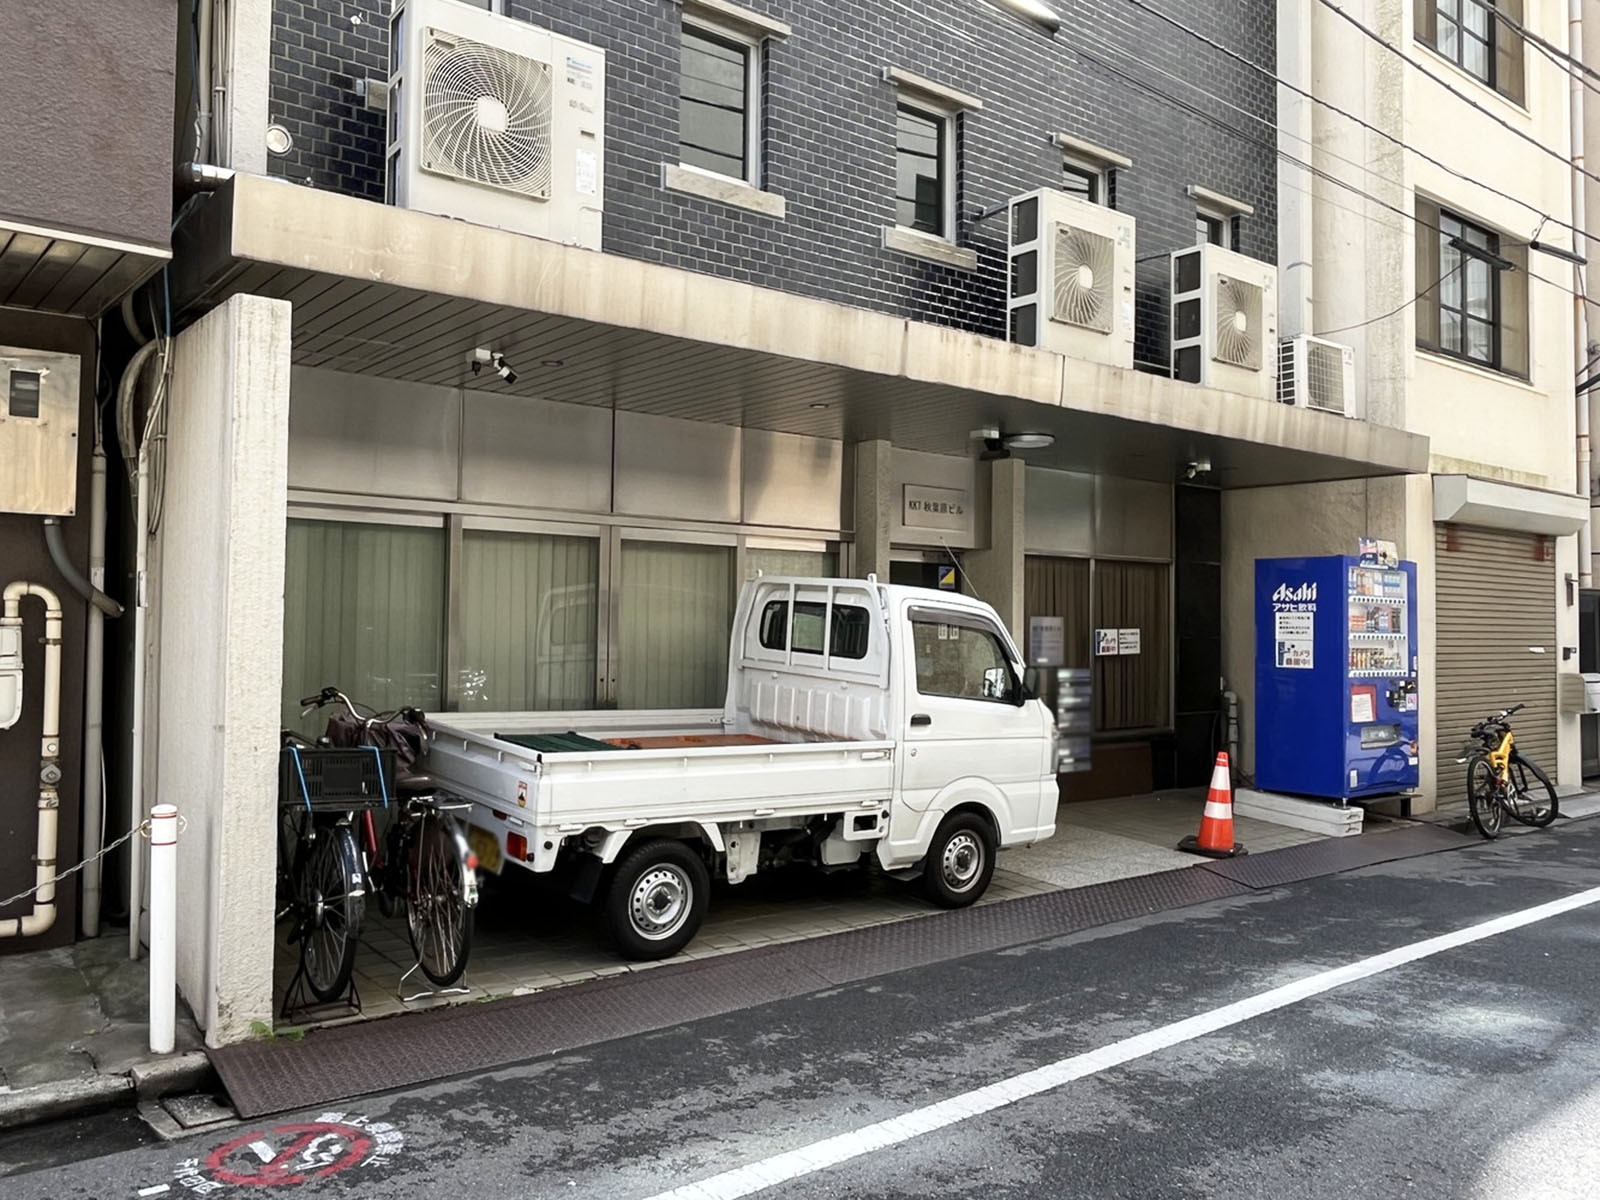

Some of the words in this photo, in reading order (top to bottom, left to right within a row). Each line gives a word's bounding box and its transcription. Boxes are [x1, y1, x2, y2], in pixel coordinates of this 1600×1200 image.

[1272, 582, 1317, 602] Asahi
[1272, 603, 1317, 612] アサヒ飲料
